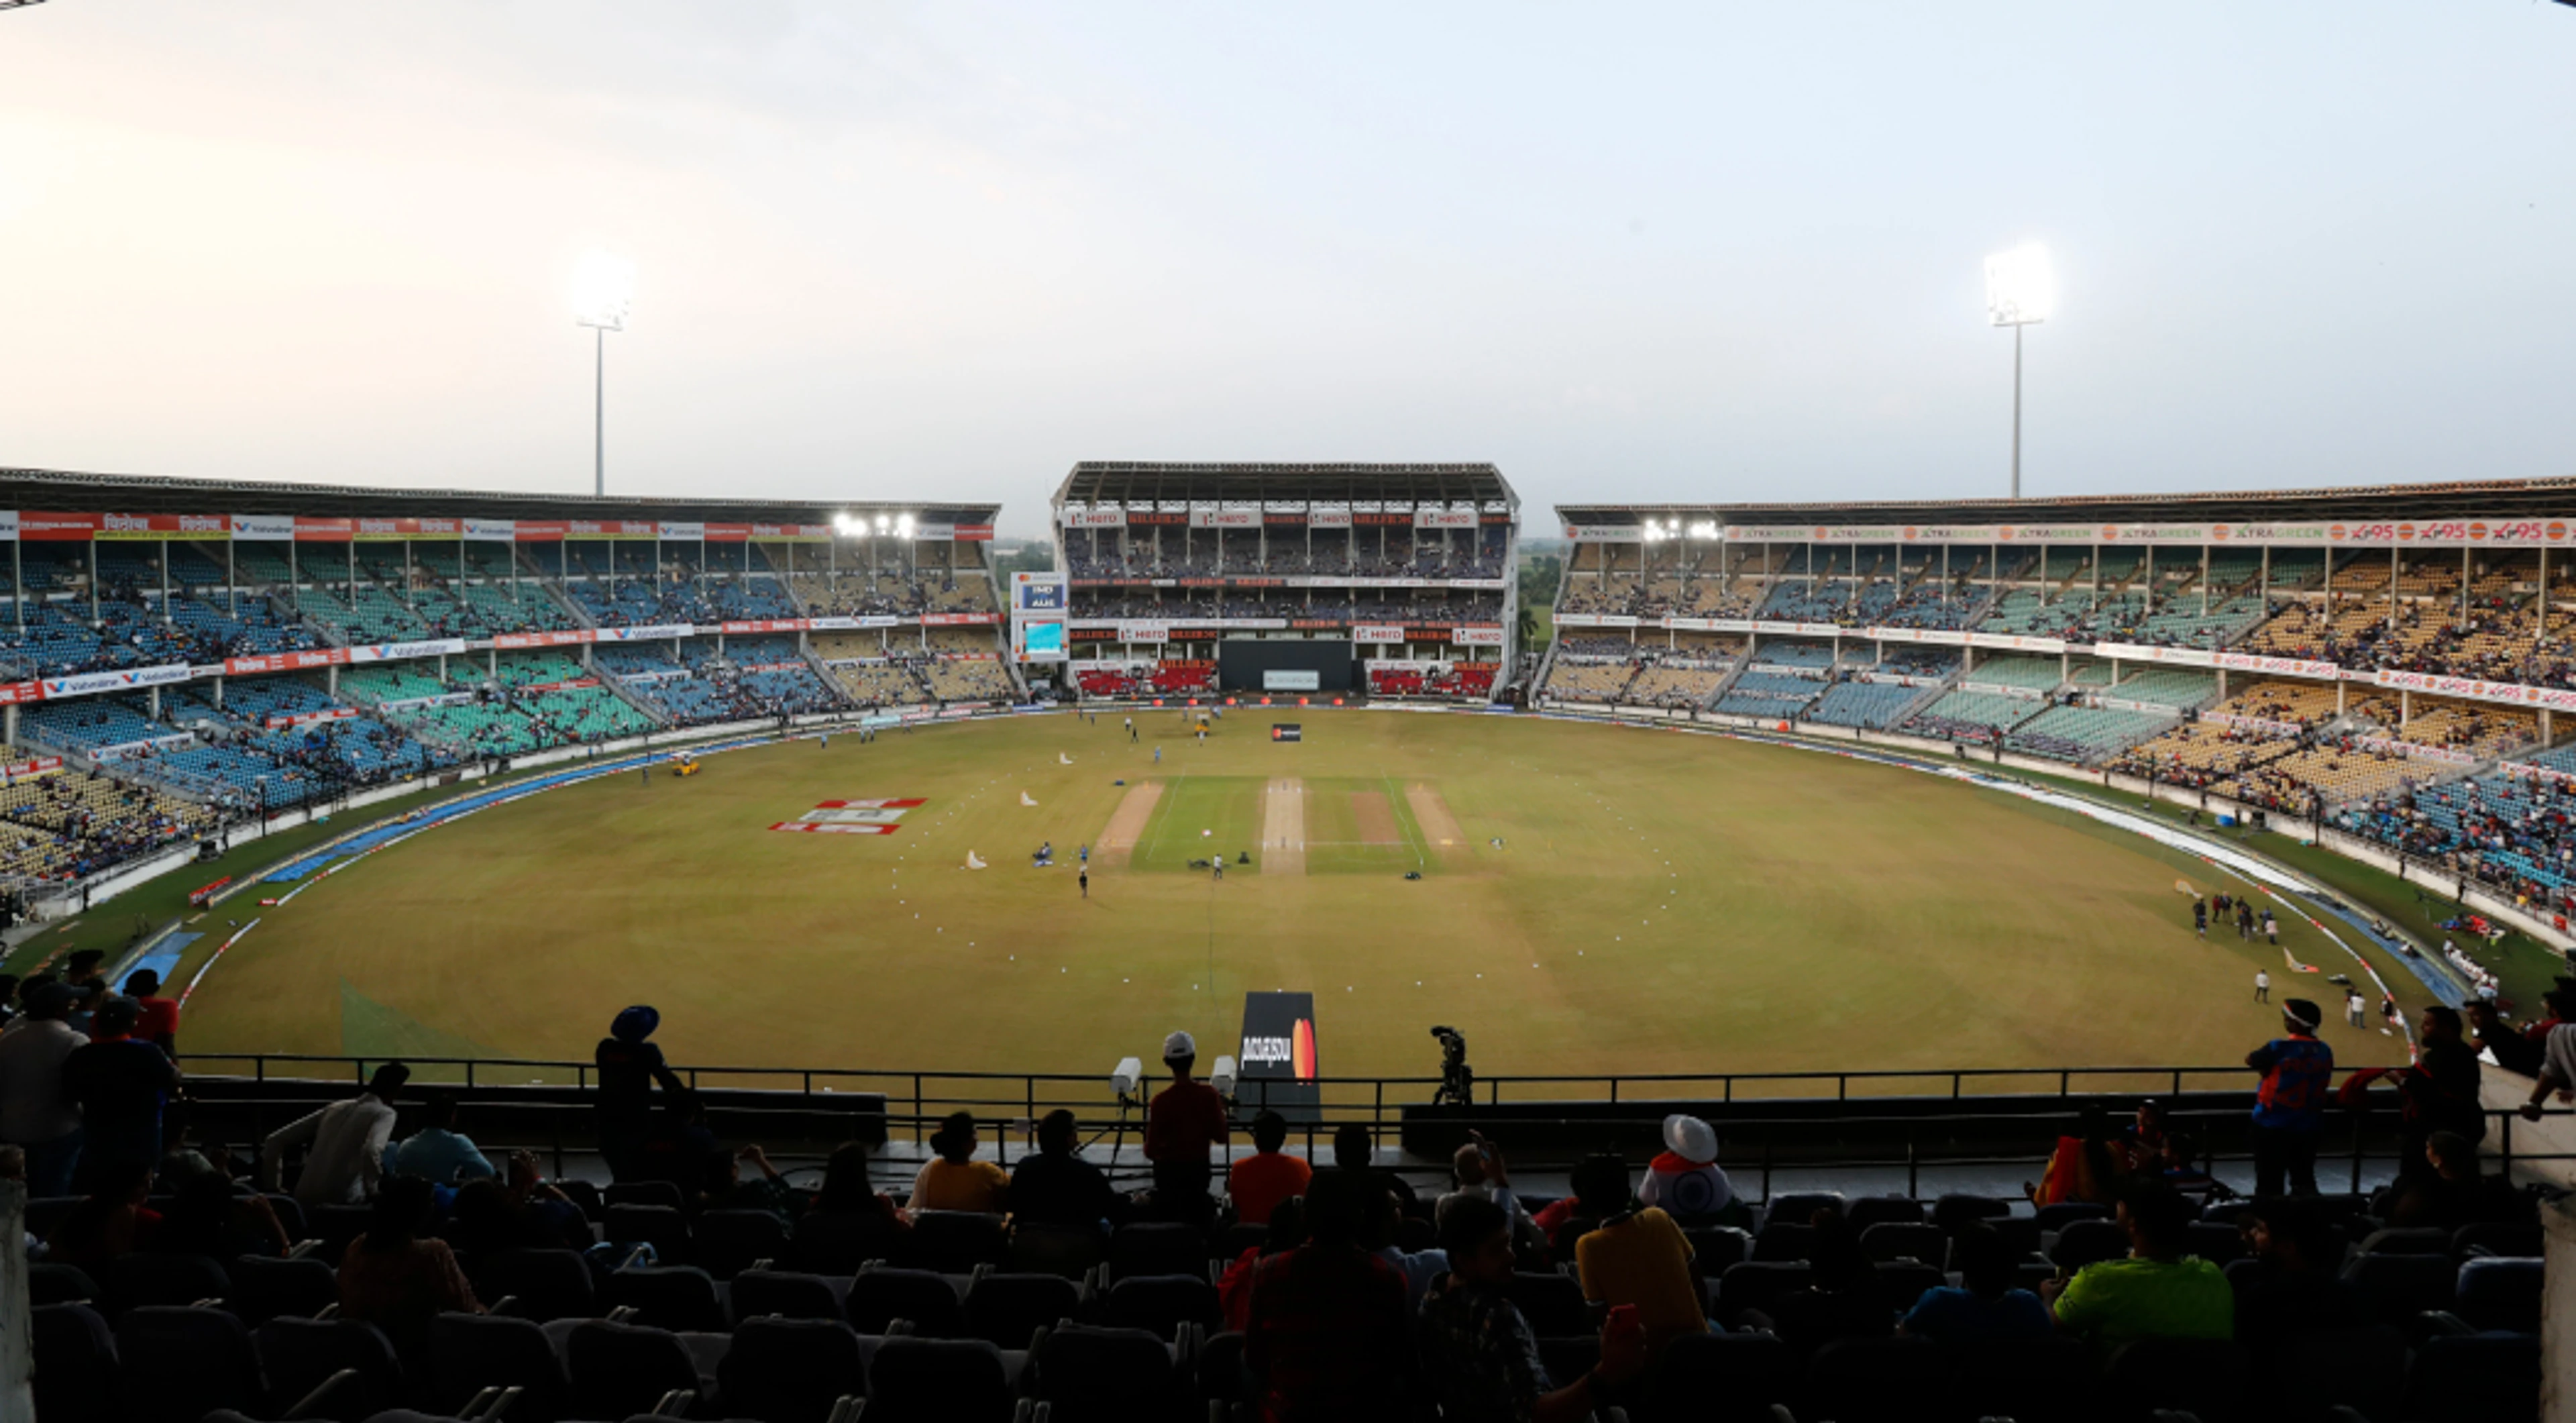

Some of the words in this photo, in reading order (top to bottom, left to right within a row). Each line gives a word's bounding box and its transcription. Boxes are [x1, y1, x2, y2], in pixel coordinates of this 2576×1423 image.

[2235, 523, 2324, 539] XTRAGREEN
[2351, 523, 2394, 540] XP95
[2420, 522, 2467, 540] XP95
[2493, 522, 2542, 540] XP95
[394, 644, 447, 656] Valvoline
[68, 679, 119, 692] Valvoline
